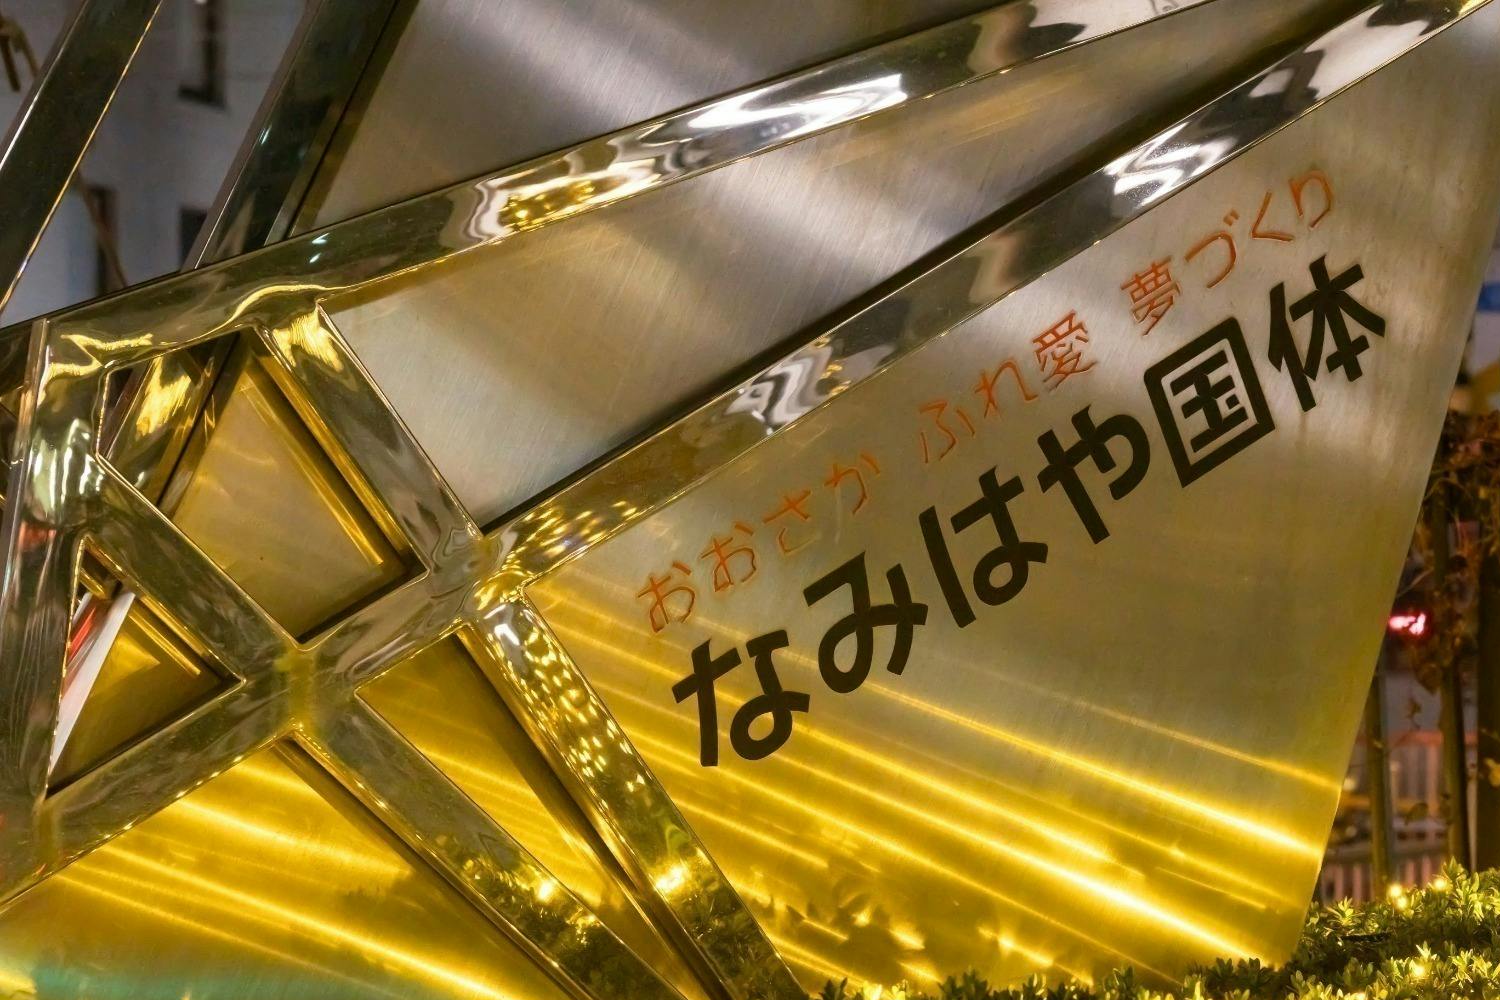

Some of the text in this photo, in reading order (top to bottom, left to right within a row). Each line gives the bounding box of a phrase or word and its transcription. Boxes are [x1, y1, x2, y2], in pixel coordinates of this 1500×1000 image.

[634, 167, 1336, 634] おおさか ふれ愛 夢づくり
[671, 254, 1387, 768] なみはや国体
